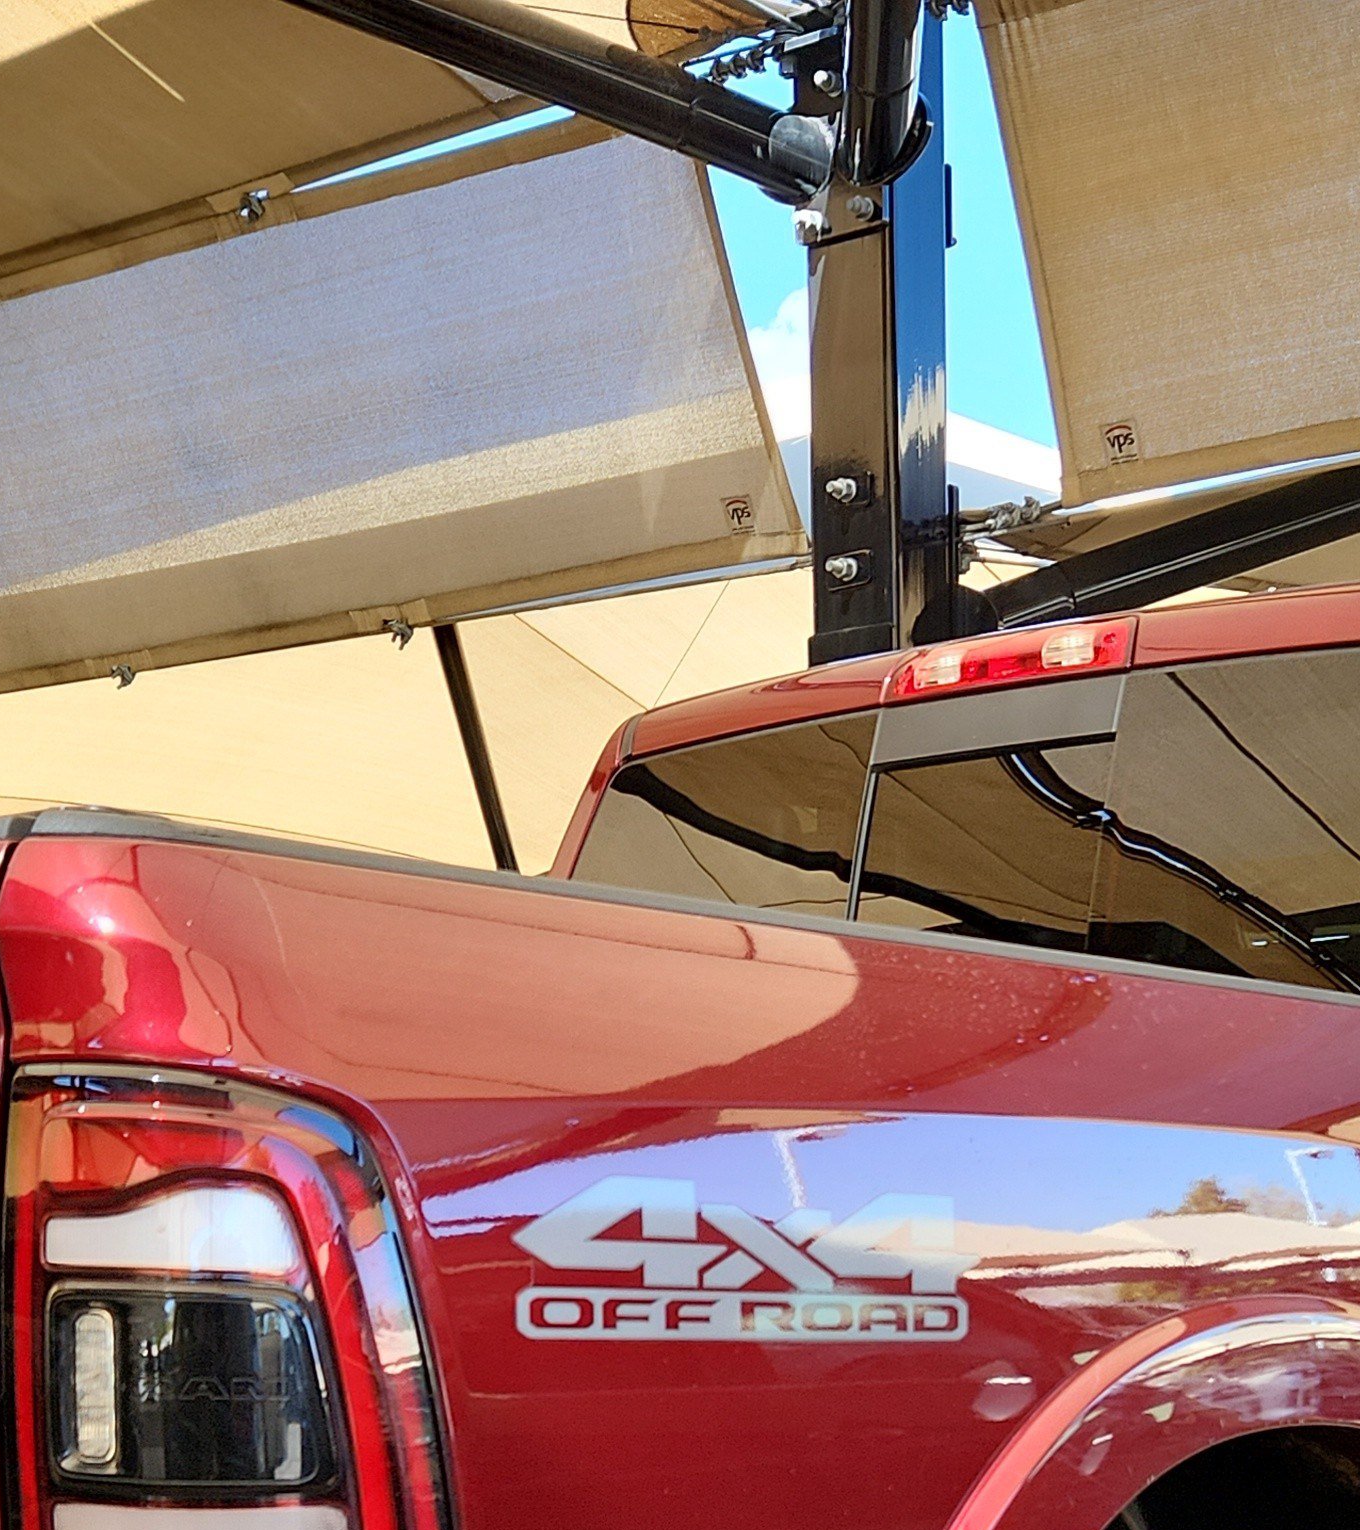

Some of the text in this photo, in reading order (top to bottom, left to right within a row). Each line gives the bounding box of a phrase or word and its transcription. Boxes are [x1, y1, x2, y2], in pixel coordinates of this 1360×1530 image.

[1107, 432, 1135, 453] vps
[529, 1297, 959, 1333] OFF ROAD
